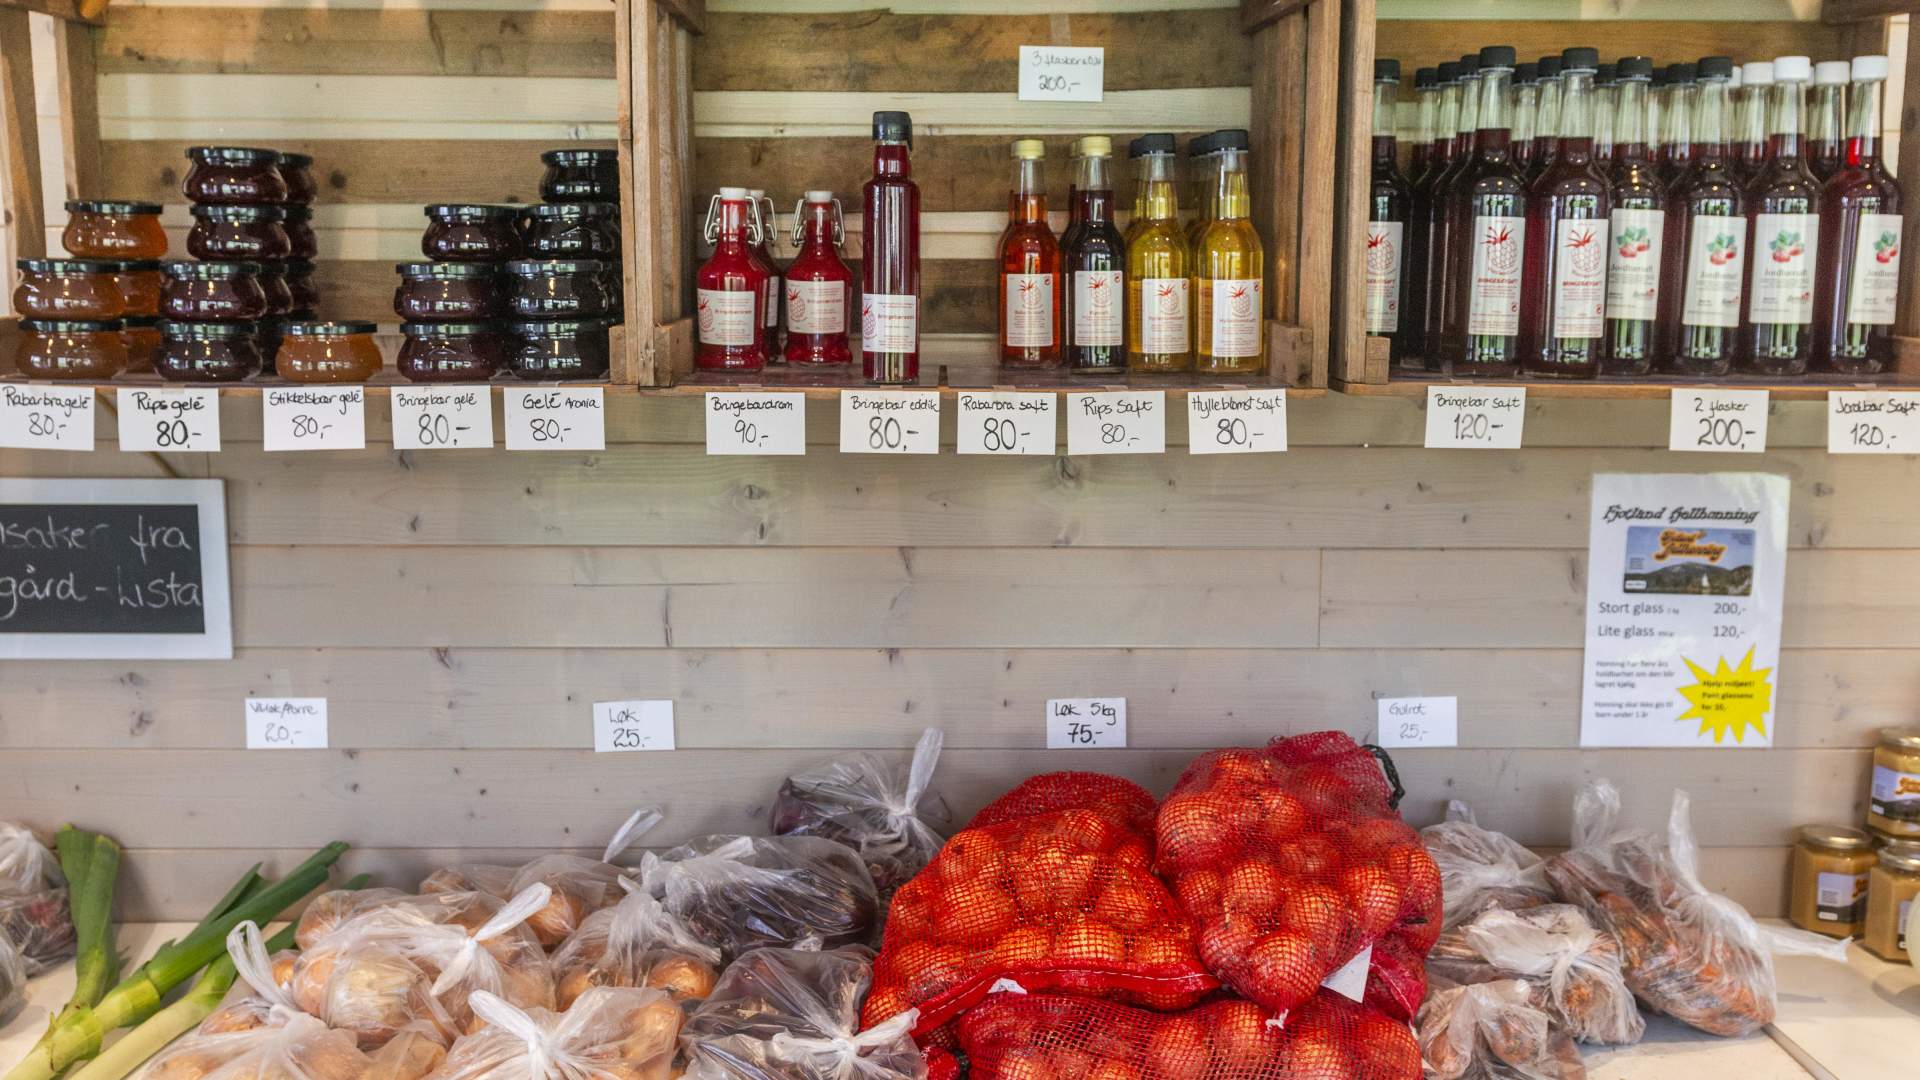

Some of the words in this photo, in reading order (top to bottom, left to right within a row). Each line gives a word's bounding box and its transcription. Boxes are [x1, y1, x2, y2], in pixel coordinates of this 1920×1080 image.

[1038, 74, 1081, 92] 200,-
[131, 391, 168, 415] Rips
[564, 398, 601, 410] Aronia
[1080, 396, 1113, 419] Rips
[1694, 397, 1704, 413] 2
[1708, 399, 1750, 419] flasker
[28, 411, 67, 440] 80,-
[291, 414, 333, 439] 80,-
[418, 413, 471, 446] 80,-
[530, 418, 572, 443] 80,-
[734, 419, 769, 447] 90,-
[868, 416, 919, 451] 80,-
[1101, 423, 1141, 447] 80,-
[1216, 418, 1264, 449] 80,-
[1453, 413, 1504, 442] 120,-
[1697, 418, 1756, 450] 200,-
[1850, 422, 1897, 449] 120,-
[129, 514, 192, 566] fra
[116, 564, 202, 609] Lista
[1598, 601, 1630, 614] Stort
[1633, 601, 1664, 617] glass
[1713, 602, 1748, 616] 200,-
[1597, 625, 1621, 637] Lite
[1623, 625, 1655, 640] glass
[1713, 625, 1746, 639] 120,-
